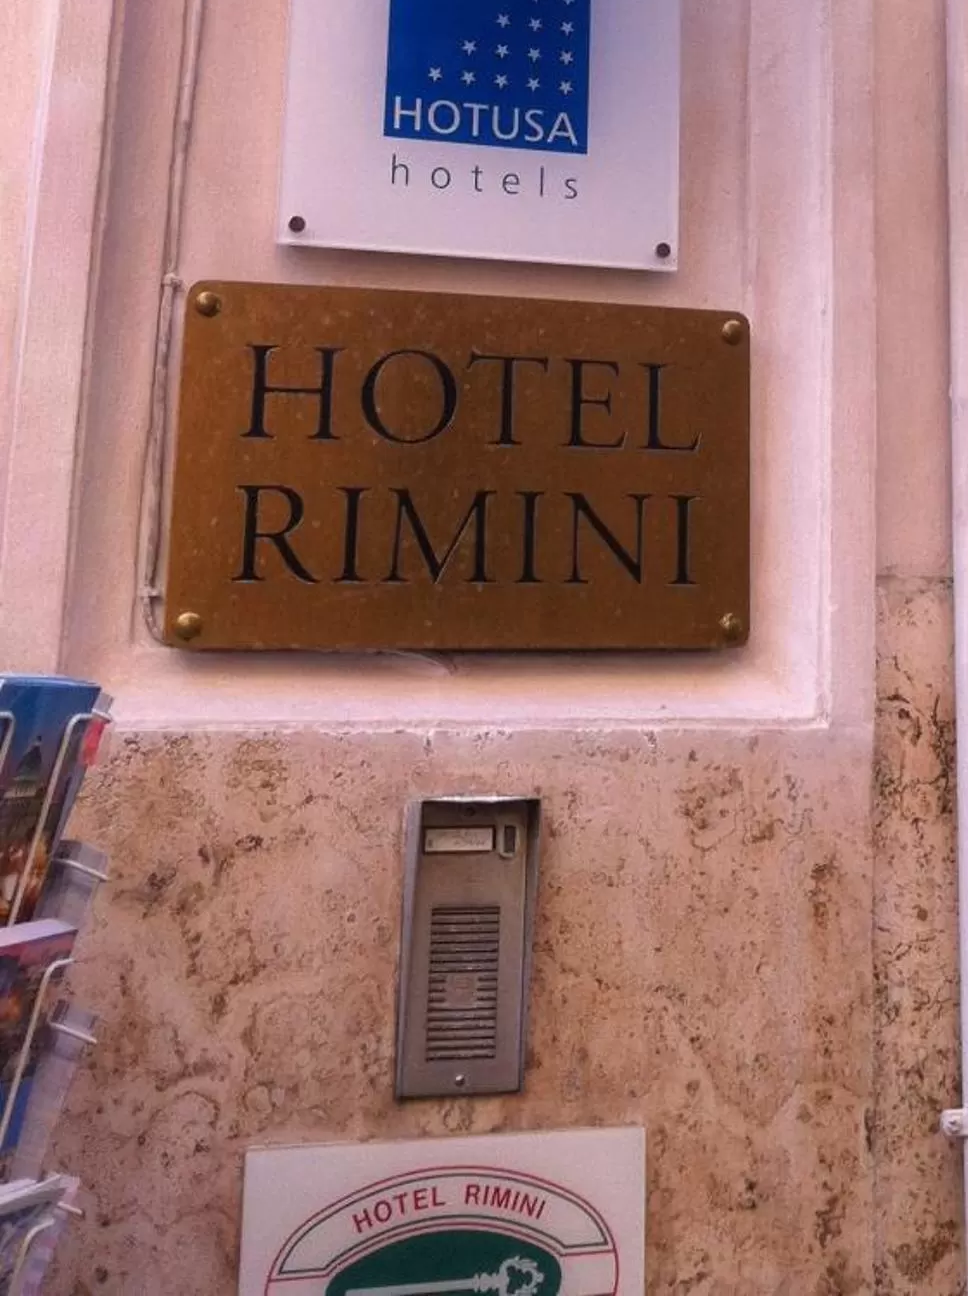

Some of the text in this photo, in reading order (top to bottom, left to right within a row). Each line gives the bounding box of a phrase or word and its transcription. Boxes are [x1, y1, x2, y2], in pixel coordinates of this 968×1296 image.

[393, 95, 578, 146] HOTUSA
[391, 153, 579, 200] hotels
[240, 344, 701, 452] HOTEL
[231, 484, 701, 585] RIMINI
[352, 1183, 546, 1233] HOTEL RIMINI
